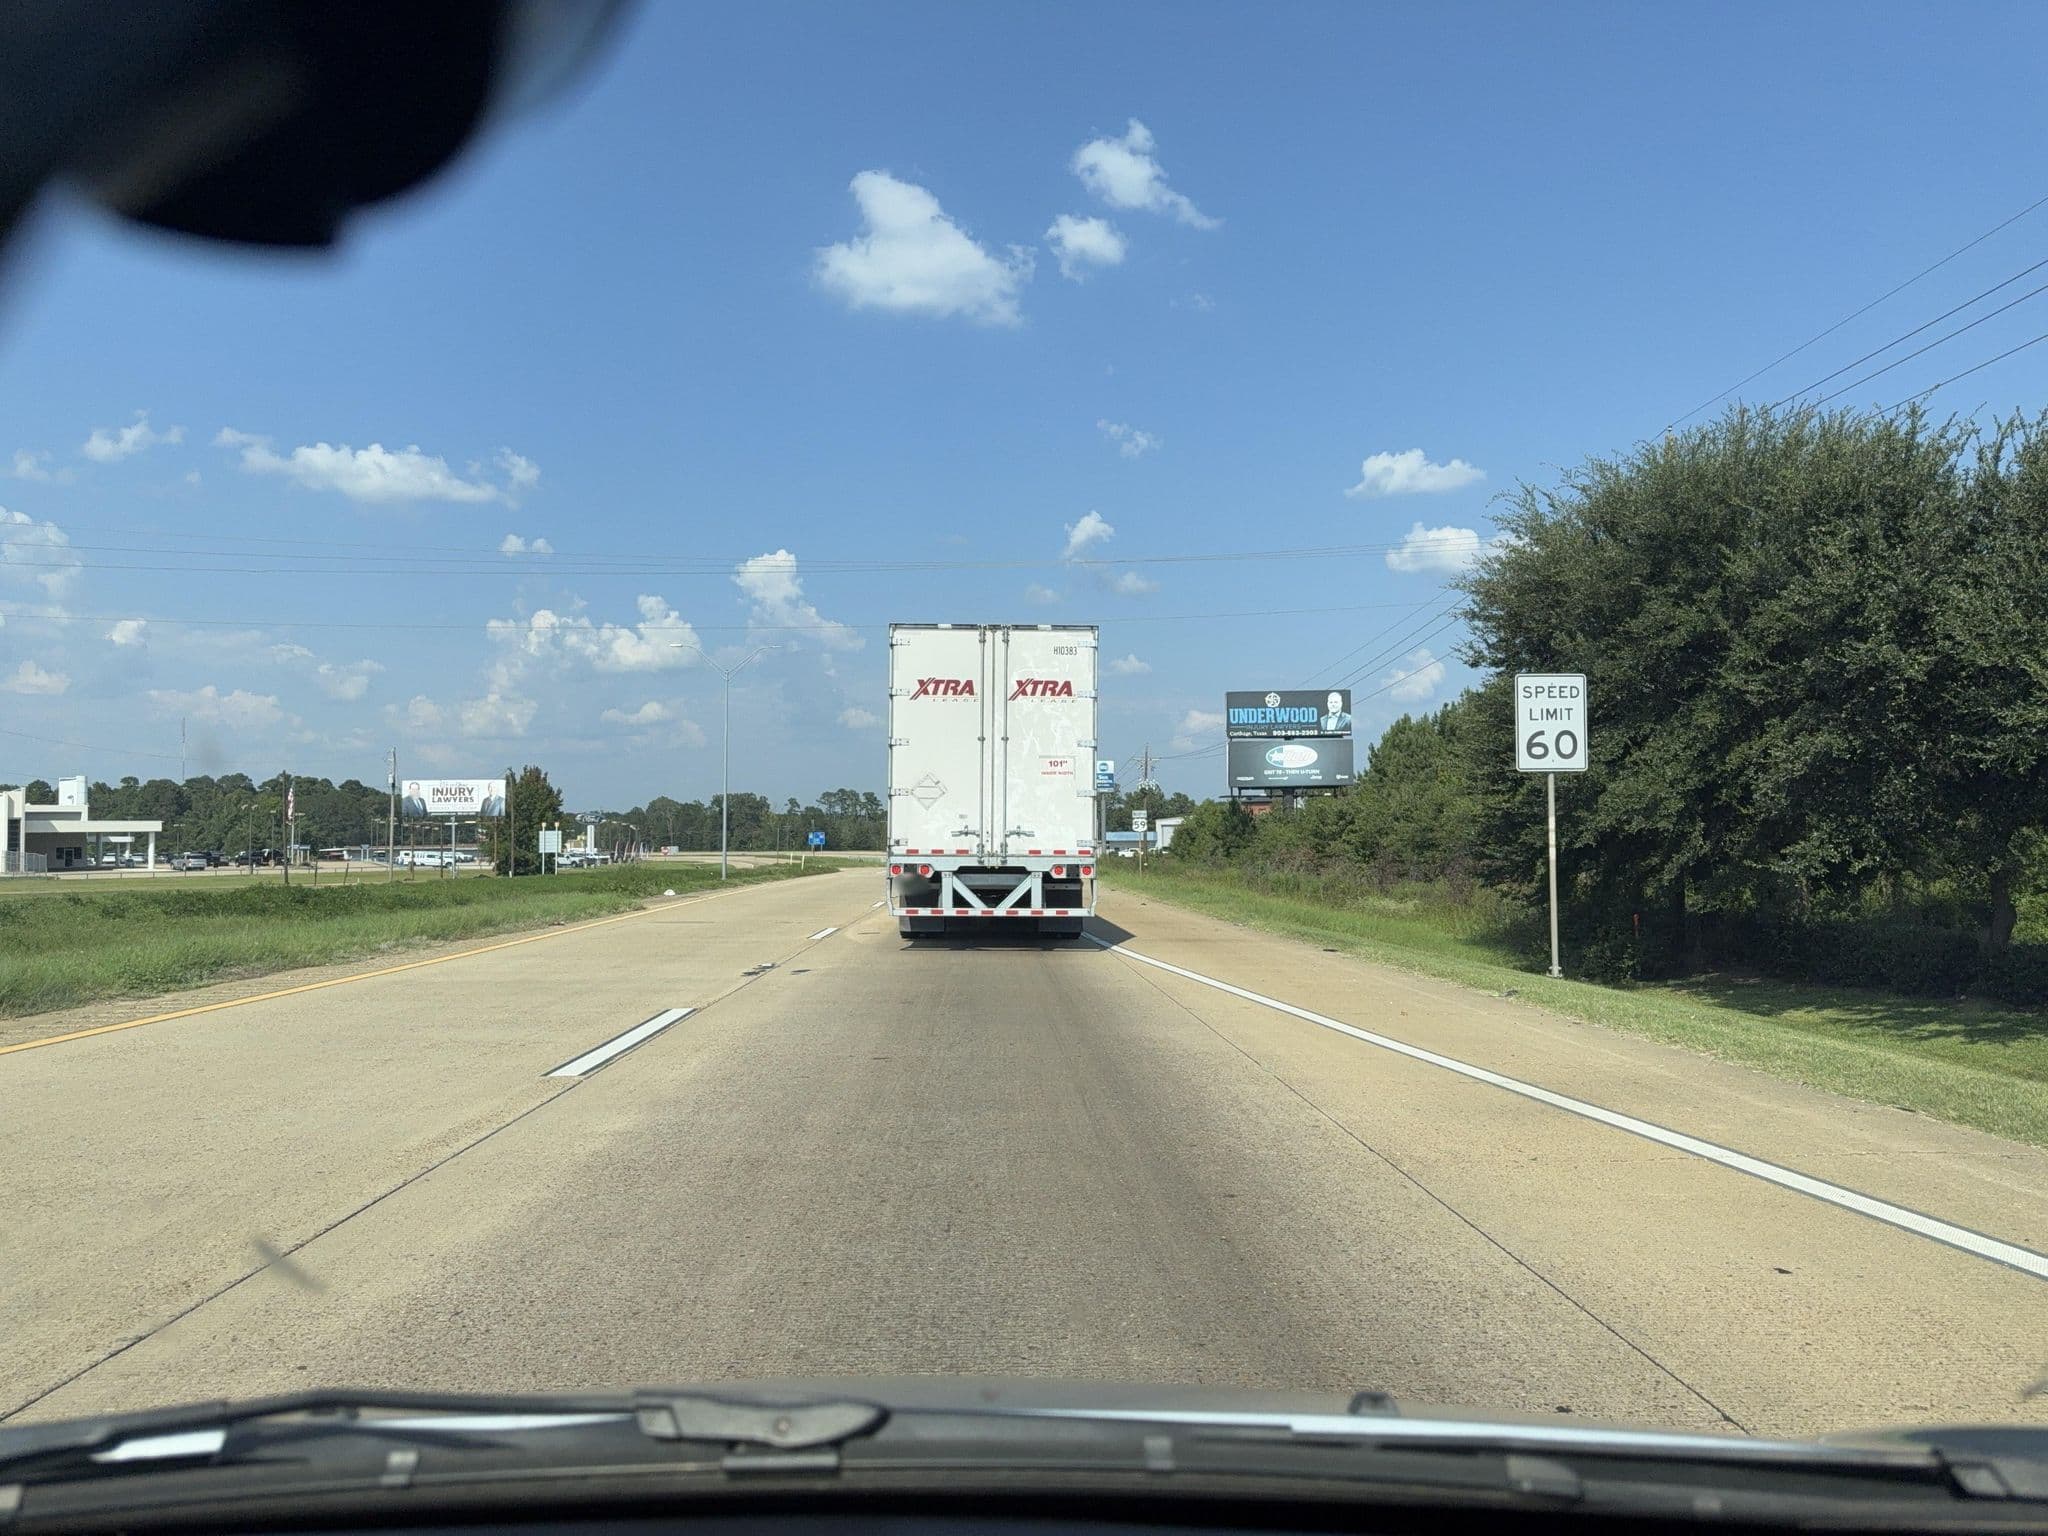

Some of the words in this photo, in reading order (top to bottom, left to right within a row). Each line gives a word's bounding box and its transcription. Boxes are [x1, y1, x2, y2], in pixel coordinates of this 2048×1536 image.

[909, 677, 975, 701] XTRA
[1008, 678, 1073, 701] XTRA
[1522, 685, 1580, 699] SPEED
[1229, 707, 1318, 724] UNDERWOOD
[1529, 708, 1573, 721] LIMIT
[1526, 729, 1578, 760] 60
[432, 787, 474, 796] INJURY
[1134, 820, 1146, 830] 59
